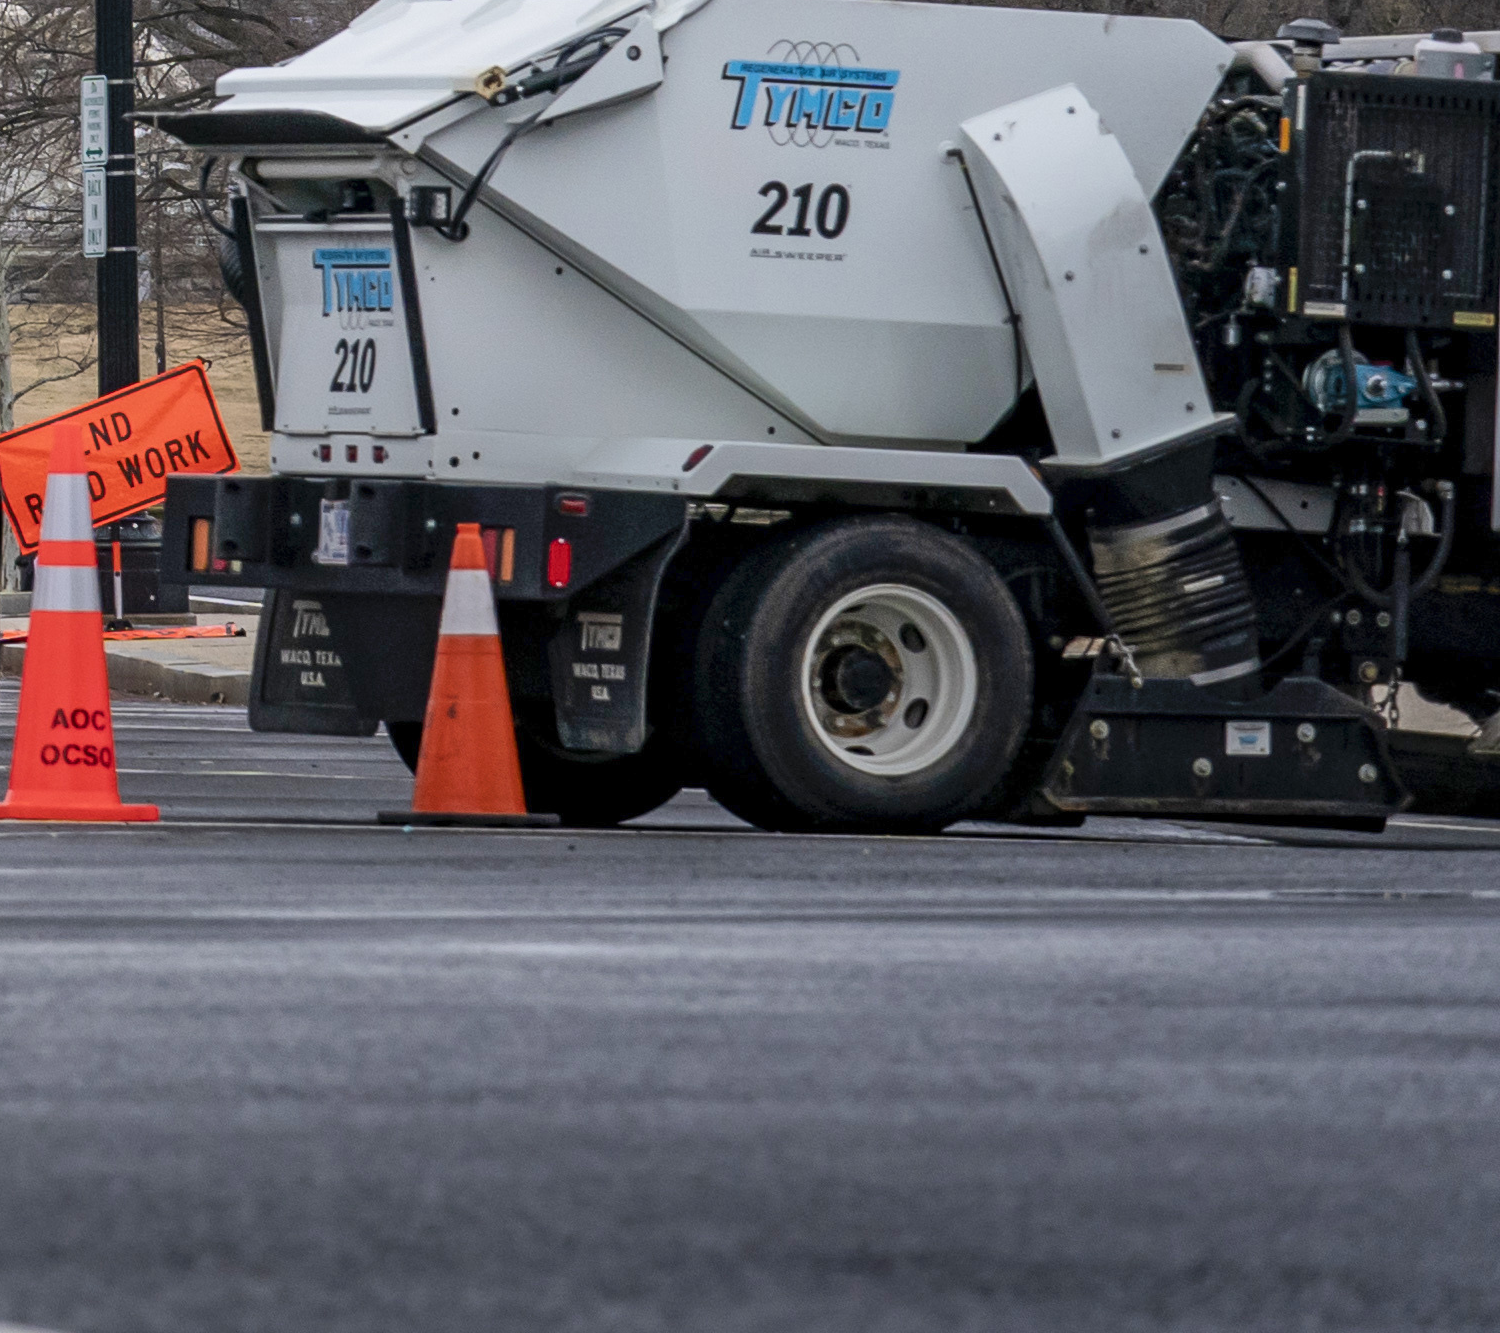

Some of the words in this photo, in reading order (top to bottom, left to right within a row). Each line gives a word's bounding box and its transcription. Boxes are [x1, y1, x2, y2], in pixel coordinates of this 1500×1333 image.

[722, 60, 900, 133] TYMCO
[750, 180, 851, 240] 210
[313, 248, 394, 317] TYMCO
[329, 337, 377, 394] 210
[84, 411, 132, 456] ND
[25, 469, 106, 524] RD
[117, 430, 211, 488] WORK
[51, 708, 107, 731] AOC
